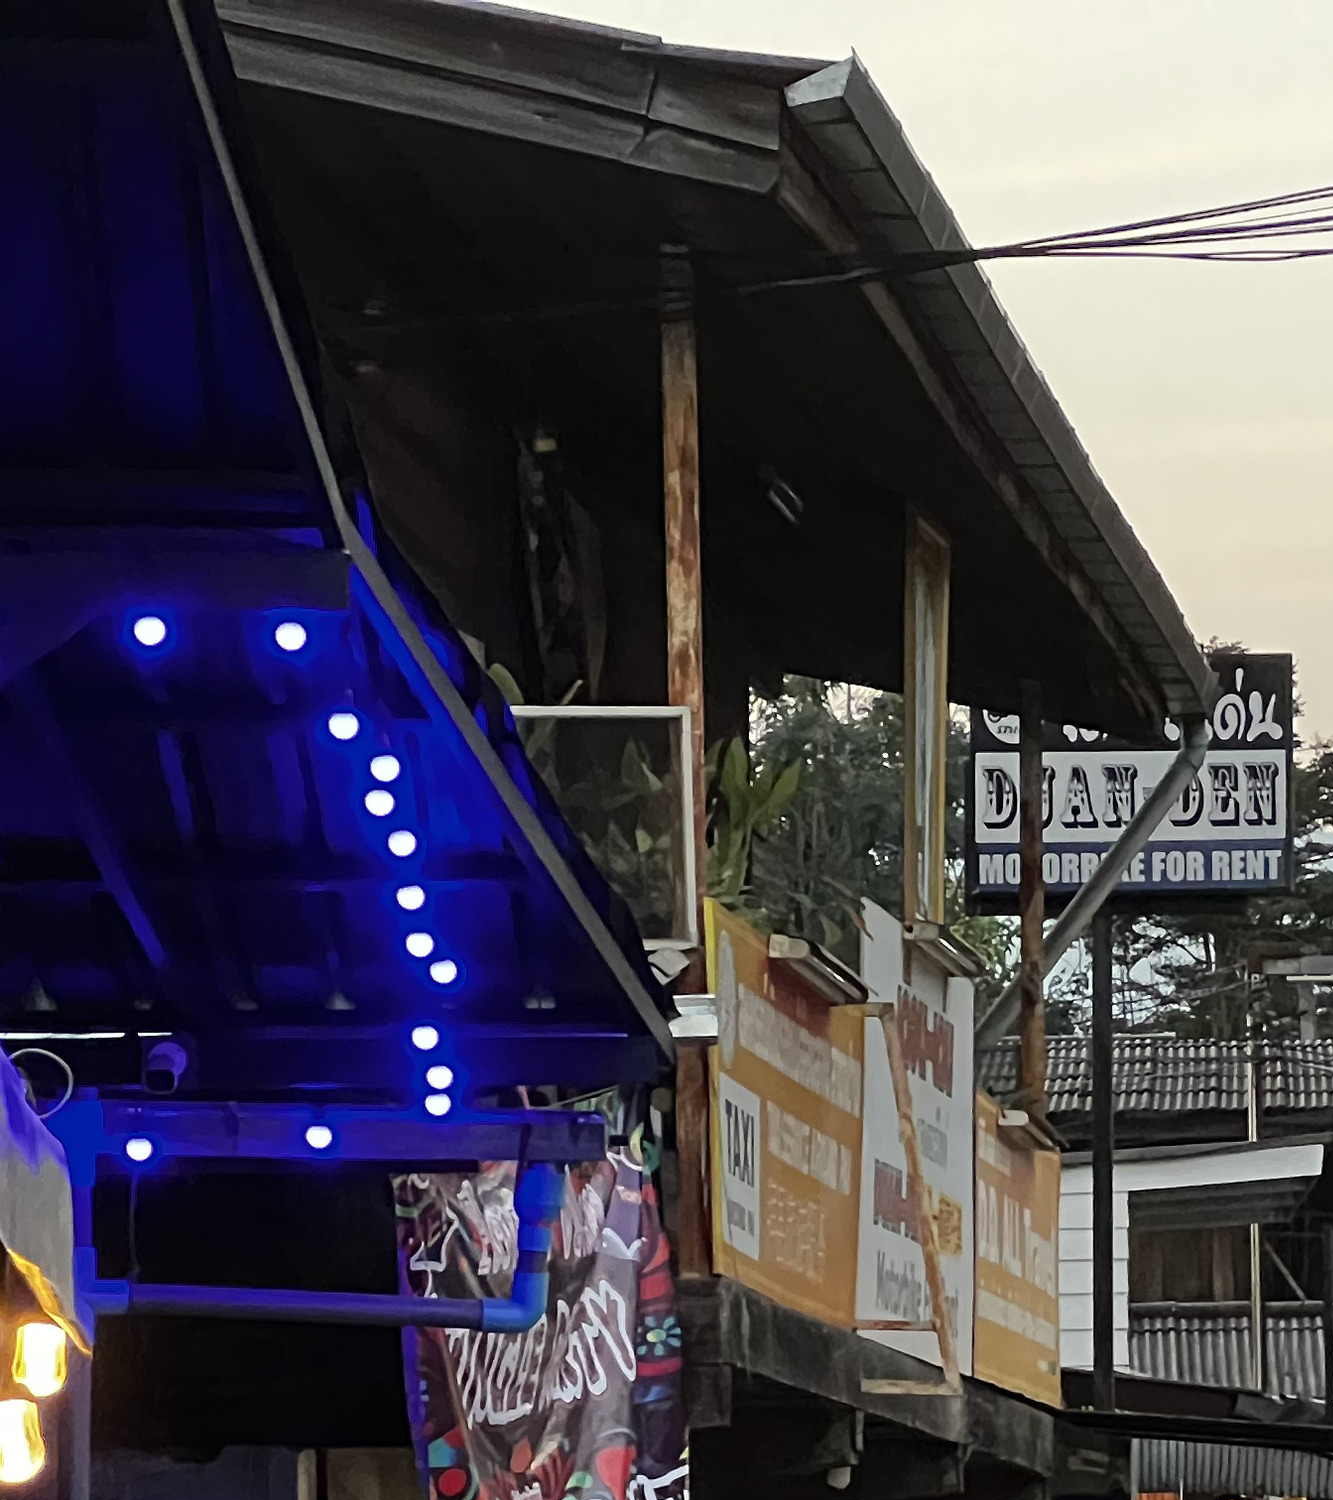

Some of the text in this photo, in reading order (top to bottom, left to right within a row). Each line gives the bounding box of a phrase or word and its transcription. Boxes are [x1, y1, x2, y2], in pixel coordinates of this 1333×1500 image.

[981, 761, 1280, 829] DAN-DEN
[979, 849, 1282, 886] MOORBE FOR RENT
[724, 1098, 756, 1189] TAXI
